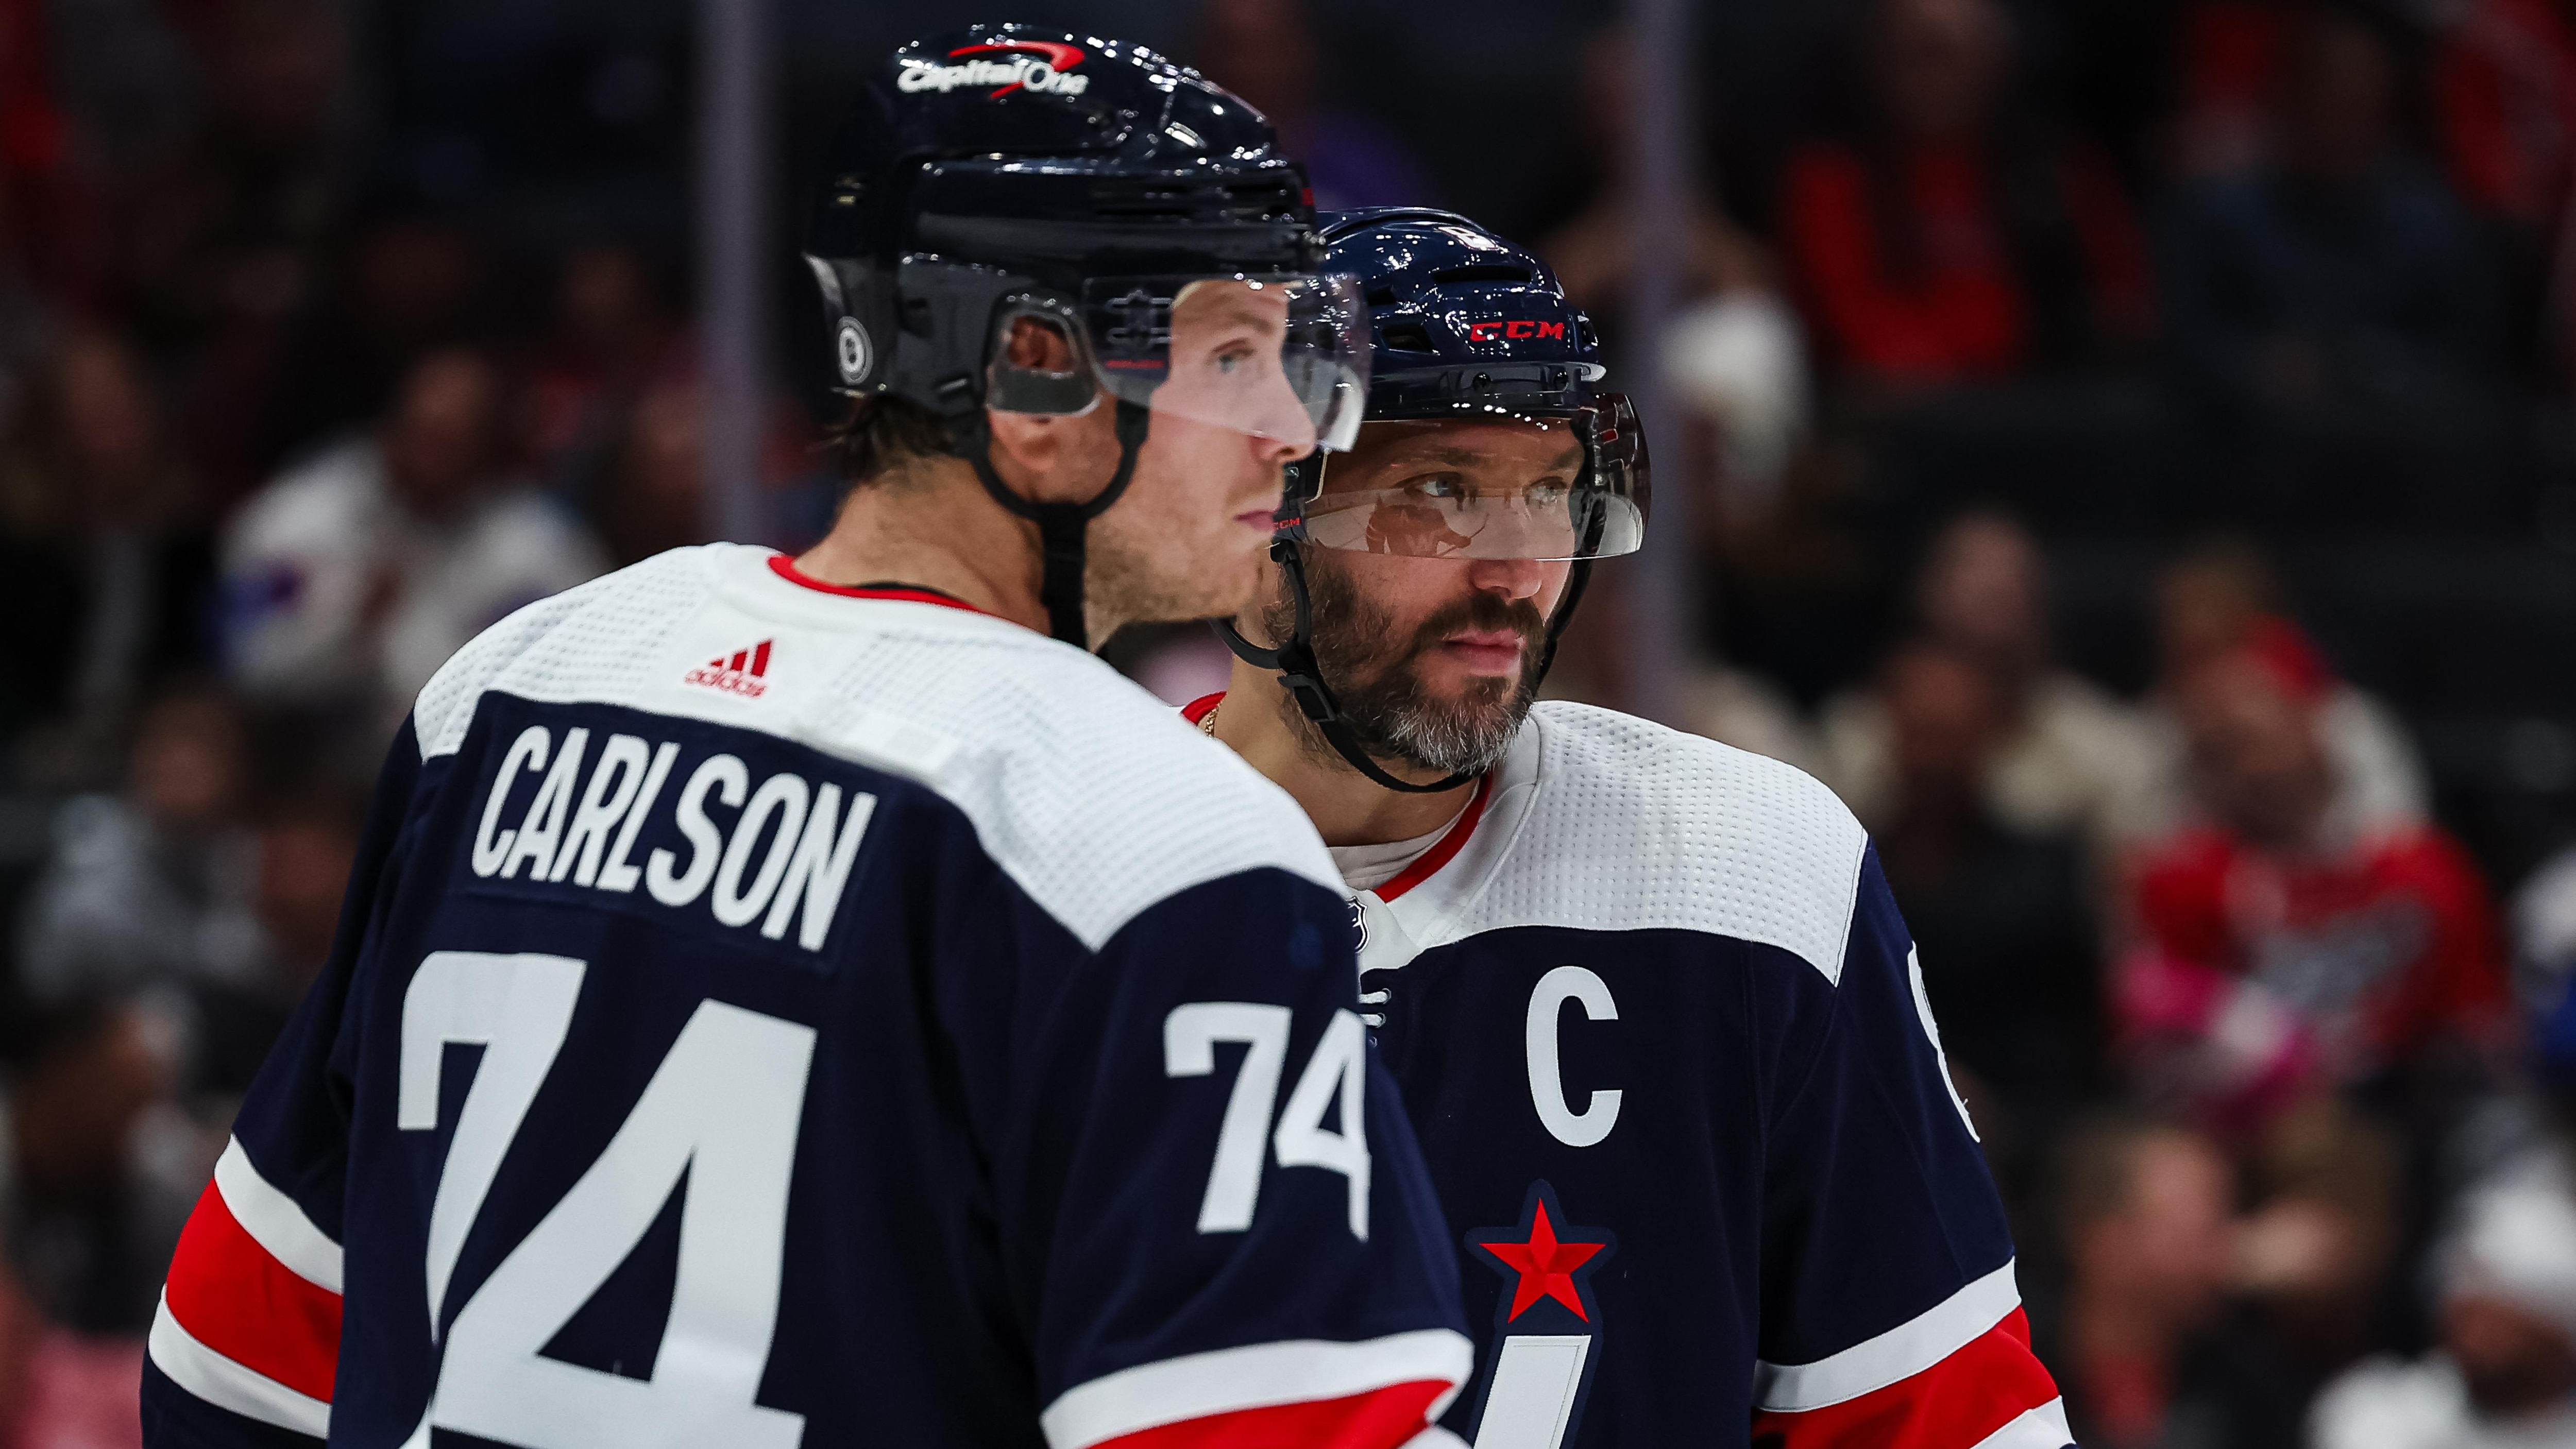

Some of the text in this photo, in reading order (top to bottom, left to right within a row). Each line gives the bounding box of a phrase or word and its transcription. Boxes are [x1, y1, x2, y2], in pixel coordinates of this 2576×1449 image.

[1470, 320, 1564, 342] CCM
[685, 669, 767, 698] adidas
[471, 725, 878, 952] CARLSON
[1163, 1001, 1372, 1242] 74
[1526, 965, 1623, 1148] C
[398, 950, 818, 1449] 74
